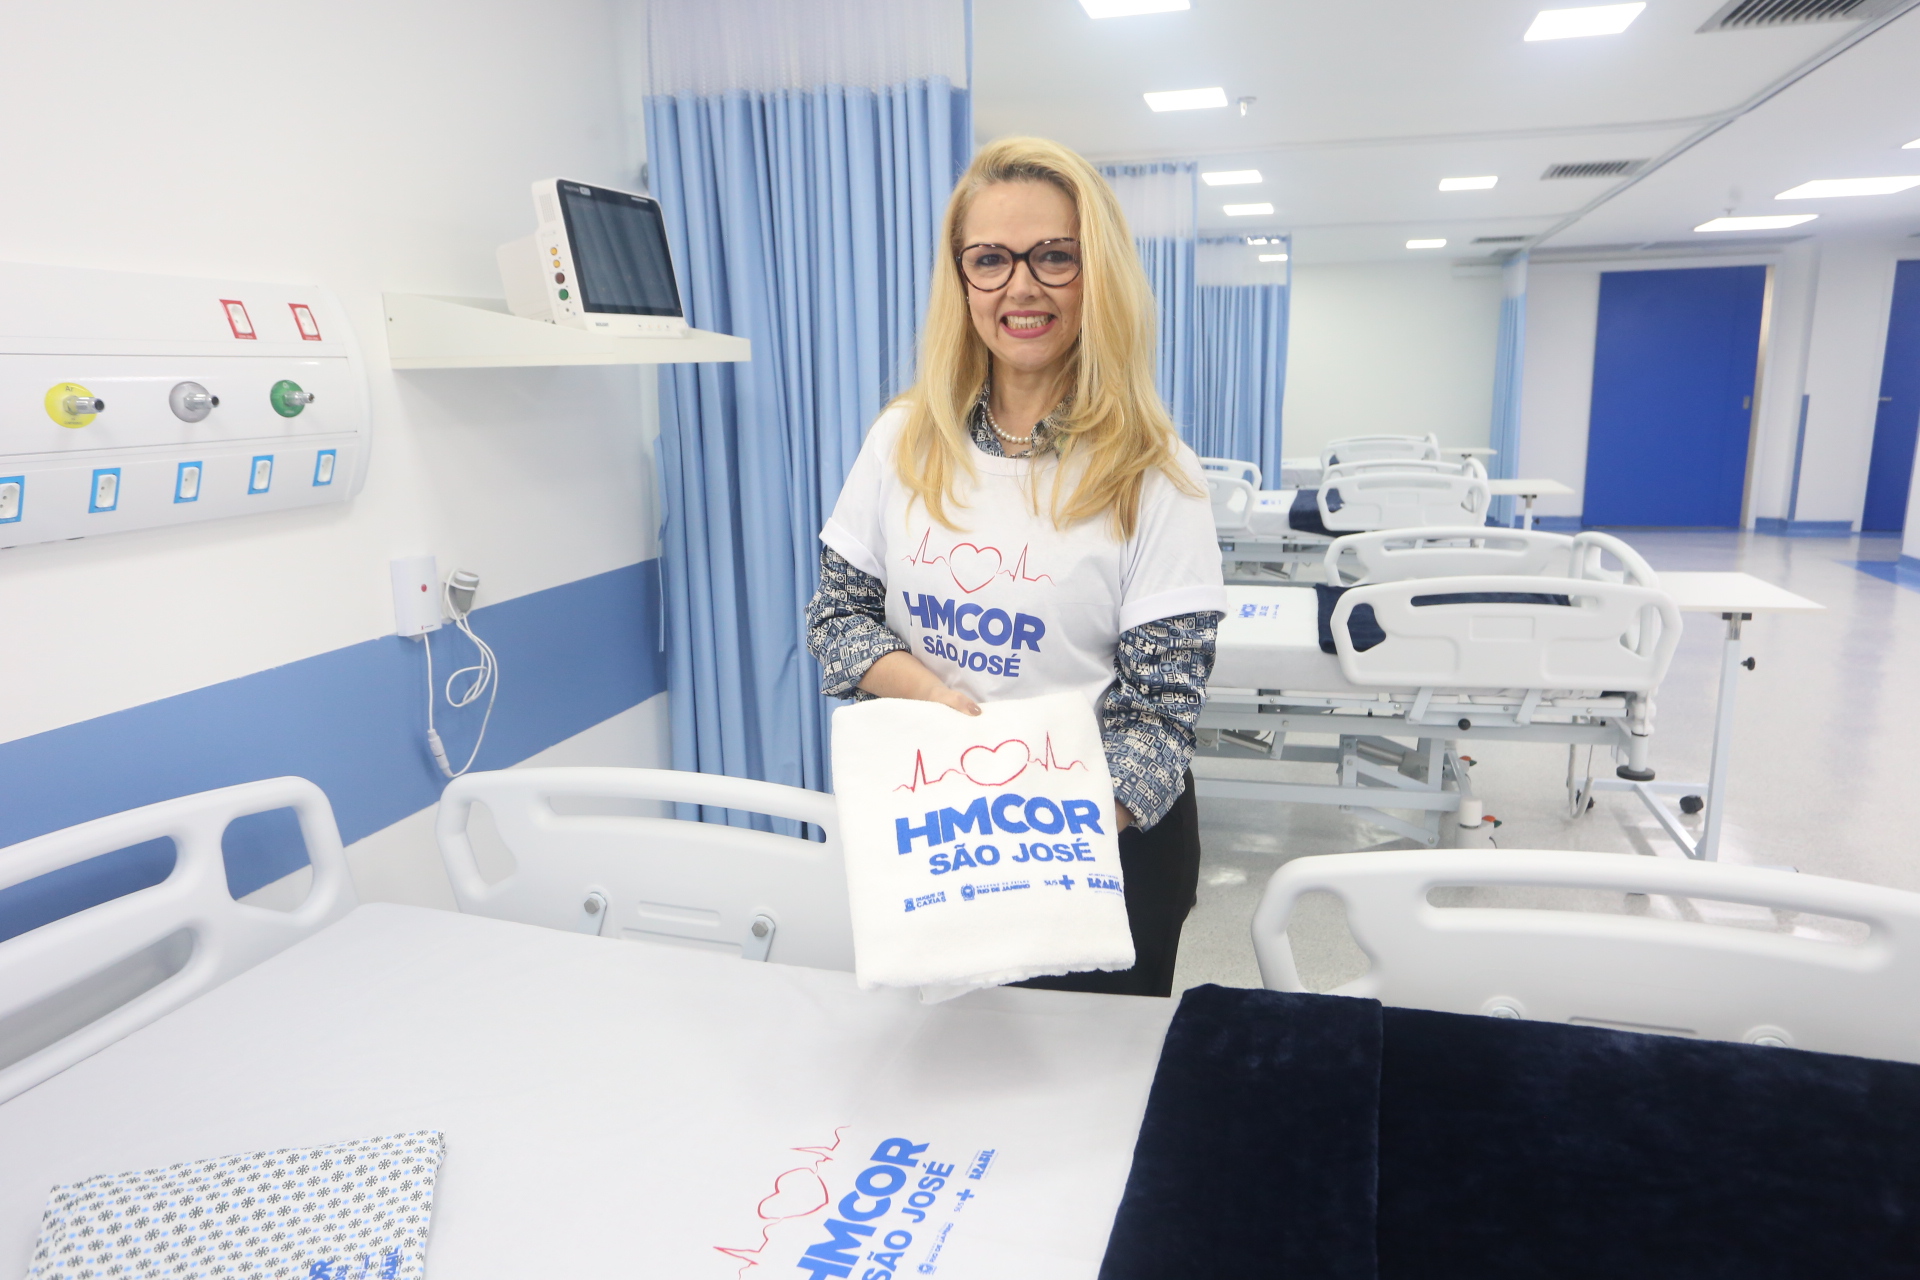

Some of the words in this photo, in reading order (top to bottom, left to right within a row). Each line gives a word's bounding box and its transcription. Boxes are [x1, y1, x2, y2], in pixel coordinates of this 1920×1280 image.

[902, 591, 1046, 652] HMCOR
[923, 635, 957, 661] SÃO
[957, 650, 1021, 677] JOSÉ
[895, 793, 1105, 855] HMCOR
[928, 843, 1001, 876] SÃO
[1011, 838, 1096, 863] JOSÉ
[916, 893, 935, 902] DUQUE
[916, 896, 947, 908] CAXIAS
[1087, 877, 1122, 893] BRASIL
[969, 1149, 995, 1179] BRASIL
[862, 1229, 913, 1280] SÃO
[902, 1161, 955, 1223] JOSÉ
